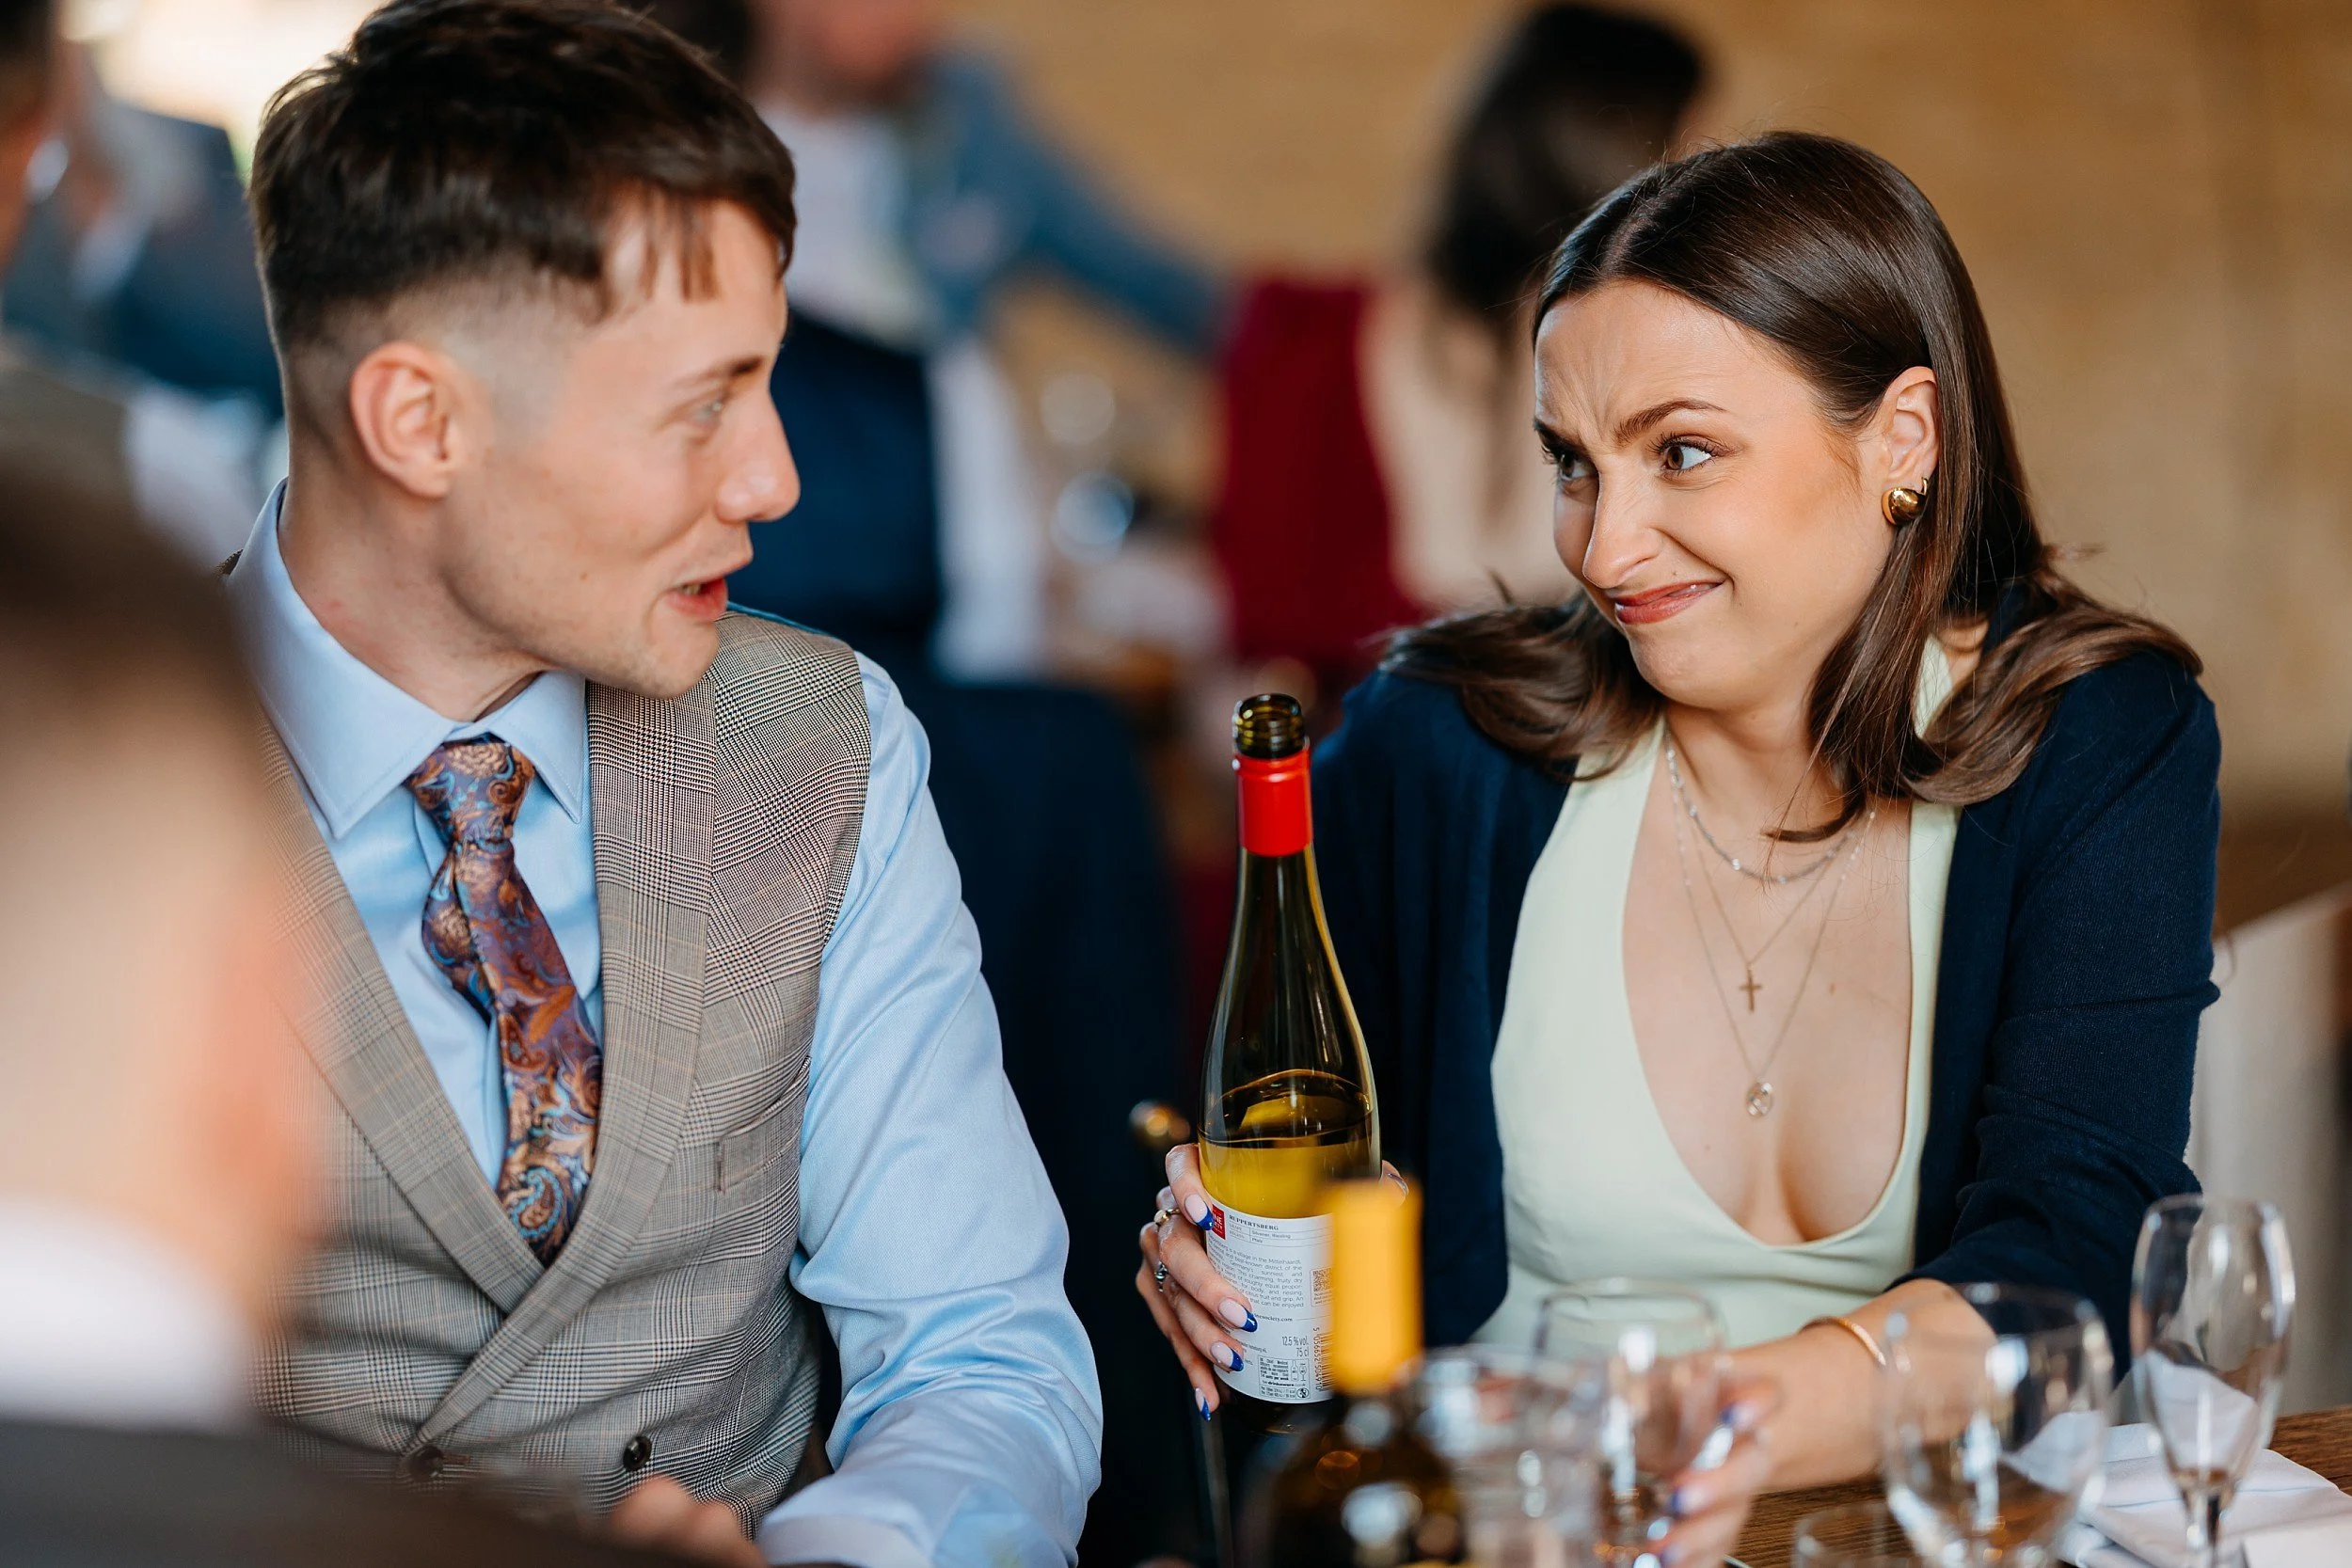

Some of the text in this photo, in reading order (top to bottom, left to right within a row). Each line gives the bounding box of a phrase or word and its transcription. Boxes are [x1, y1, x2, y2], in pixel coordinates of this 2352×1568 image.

[1229, 1214, 1279, 1231] RUPPERTSBERG
[1237, 1251, 1251, 1260] village
[1245, 1278, 1263, 1287] roughly
[1254, 1313, 1293, 1322] inesociety.com
[1281, 1336, 1293, 1346] 12.5
[1294, 1336, 1299, 1346] %
[1296, 1346, 1310, 1357] 75 cl
